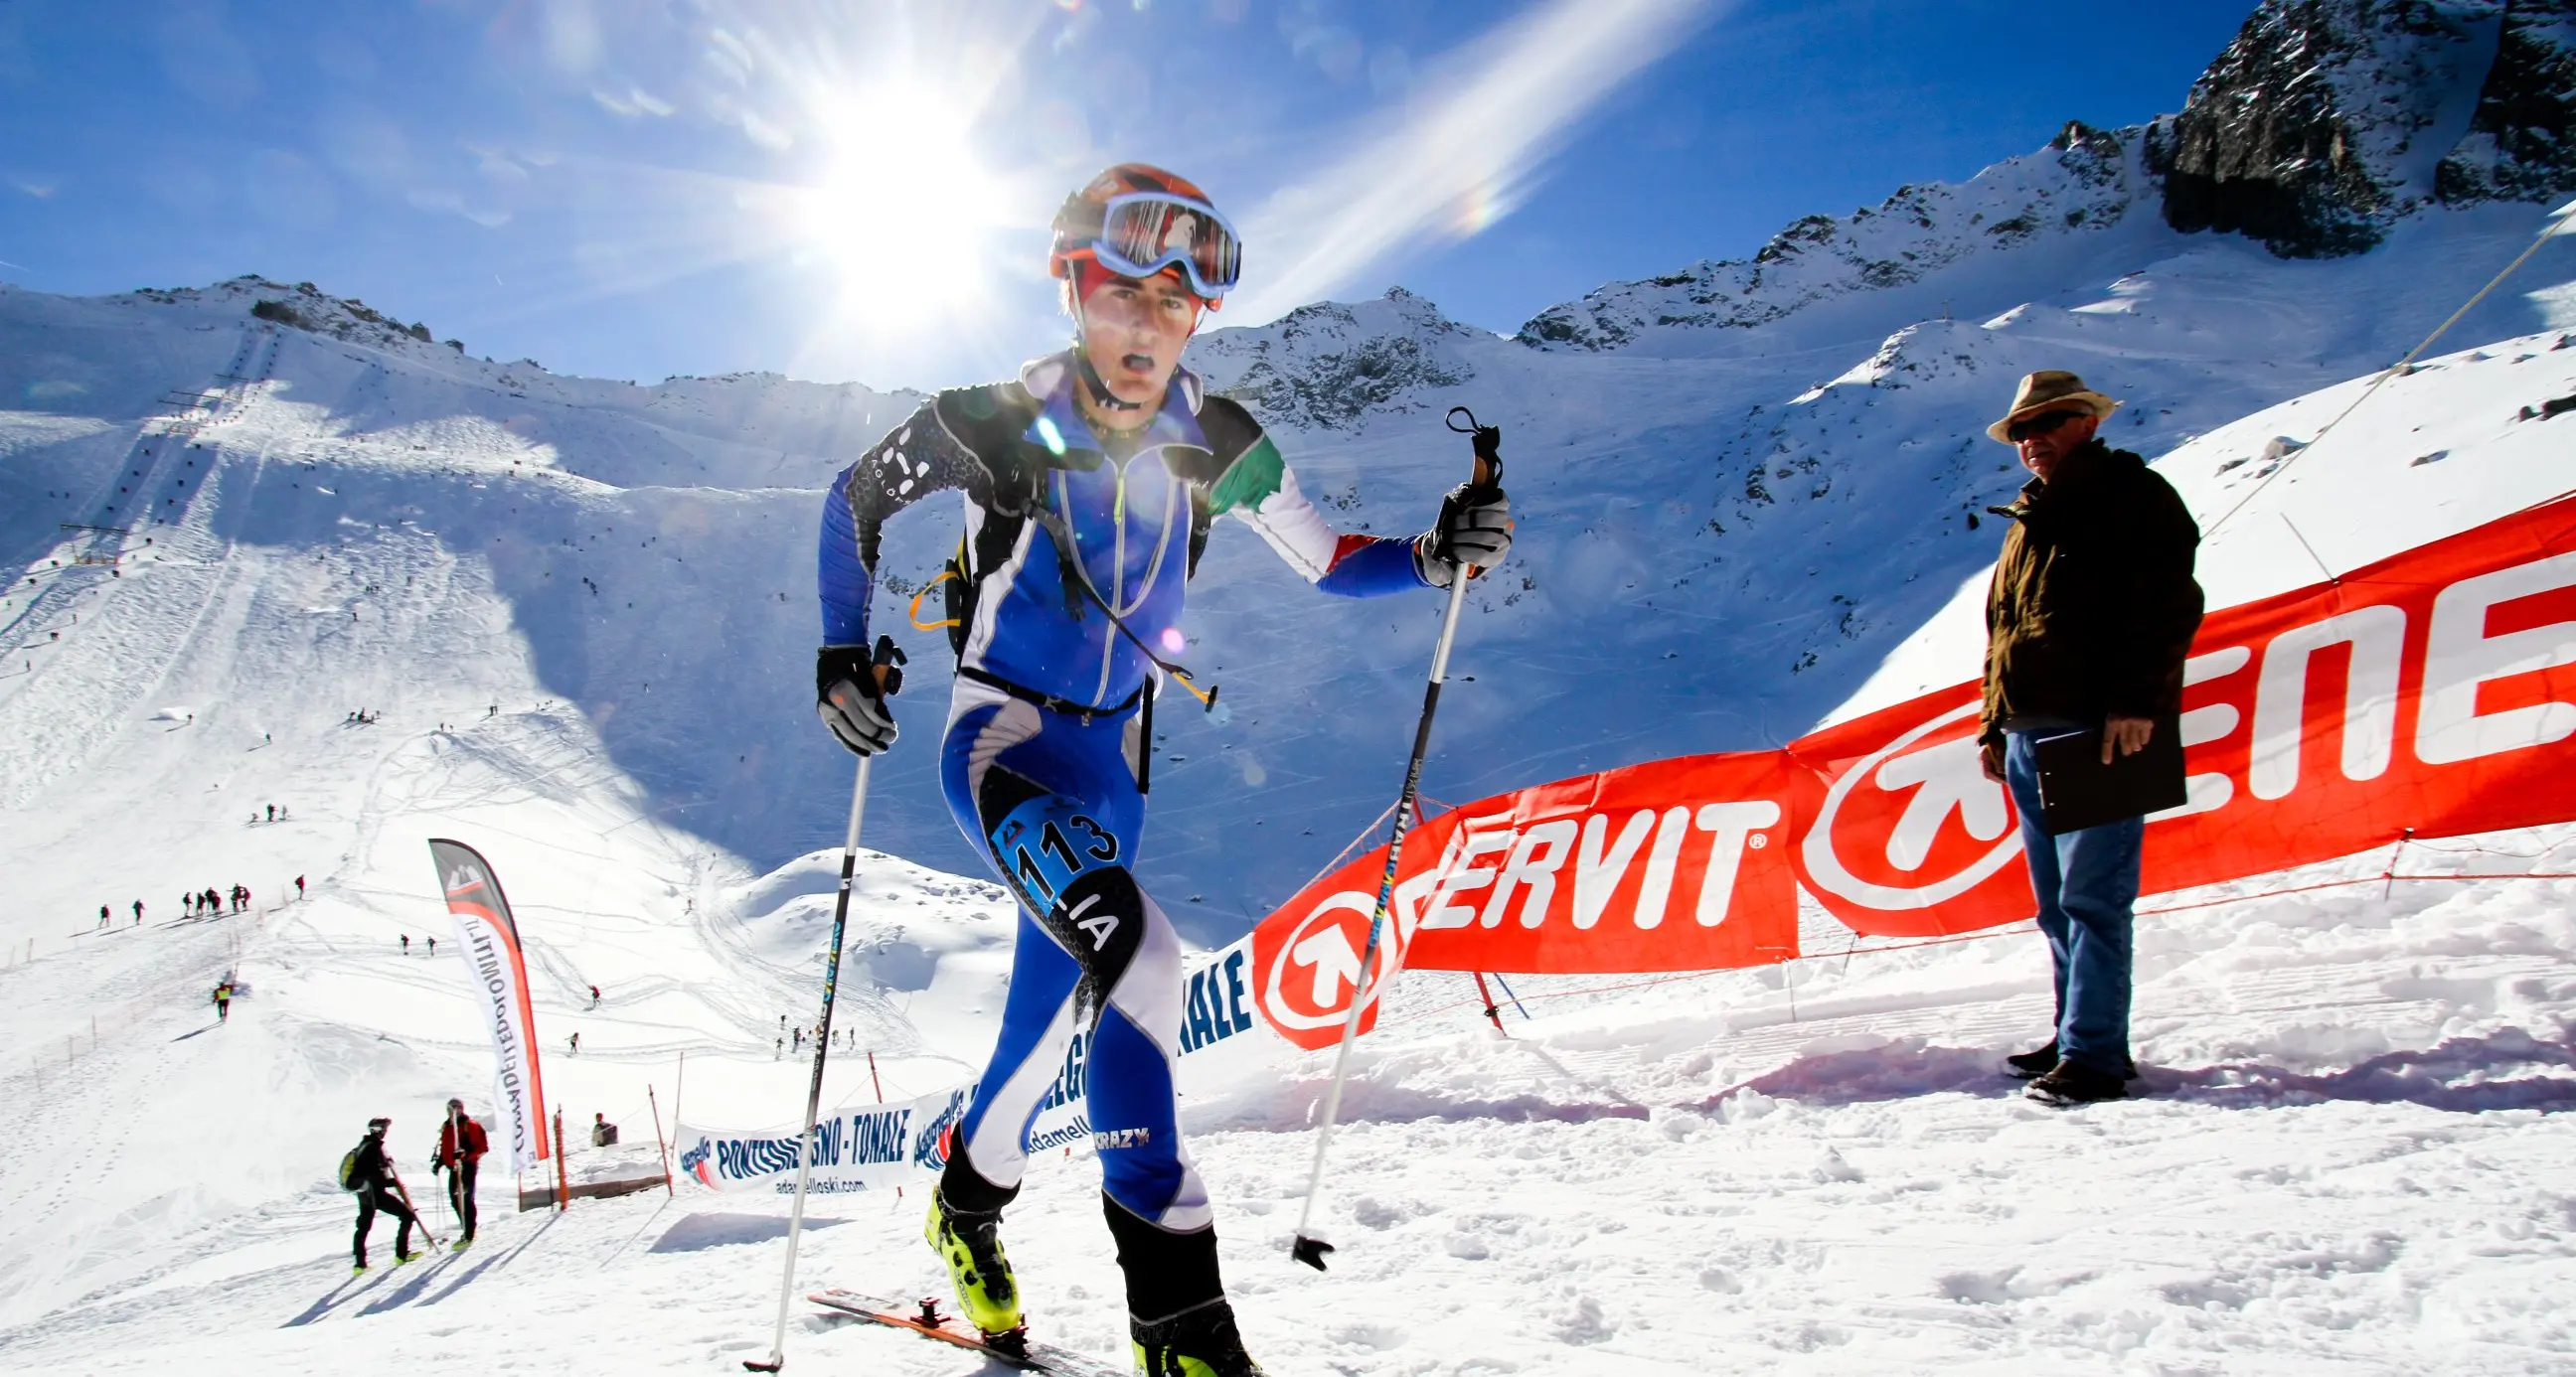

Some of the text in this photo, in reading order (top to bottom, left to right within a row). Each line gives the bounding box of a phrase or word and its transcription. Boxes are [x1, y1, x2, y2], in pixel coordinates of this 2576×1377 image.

[1016, 815, 1119, 901] 113
[1393, 800, 1781, 932] ERVIT
[717, 1116, 843, 1180] PONTEDILGNO
[852, 1109, 911, 1165] TONALE
[776, 1175, 869, 1194] adaelloski.com
